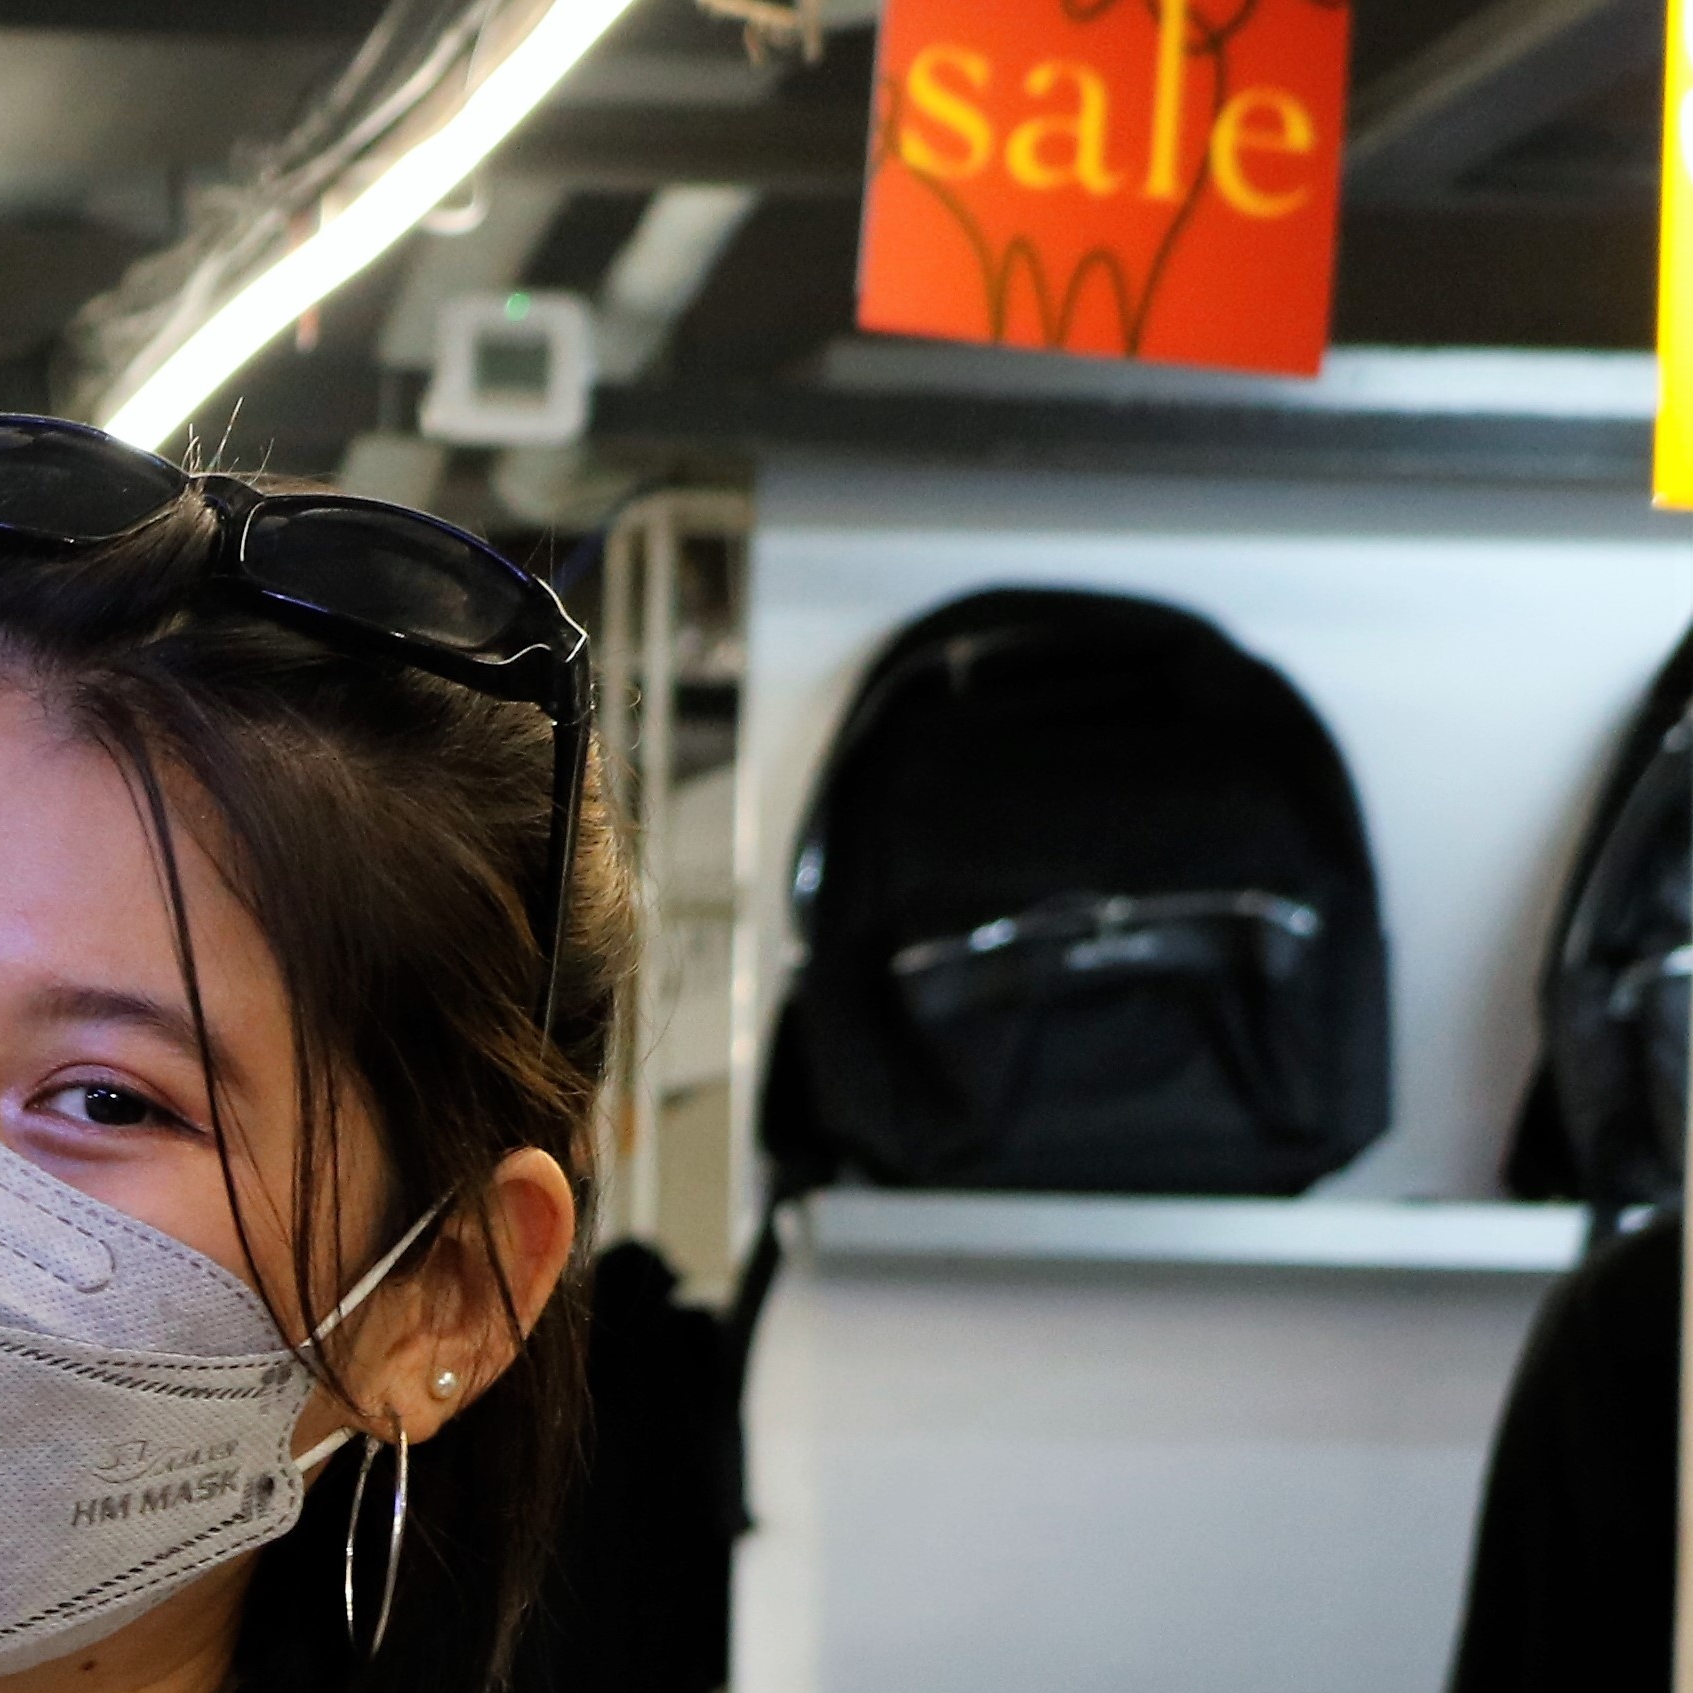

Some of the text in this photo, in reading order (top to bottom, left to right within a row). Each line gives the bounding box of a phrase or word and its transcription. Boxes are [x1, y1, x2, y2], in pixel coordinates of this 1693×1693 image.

[898, 0, 1315, 218] sale
[71, 1468, 241, 1528] HM MASK
